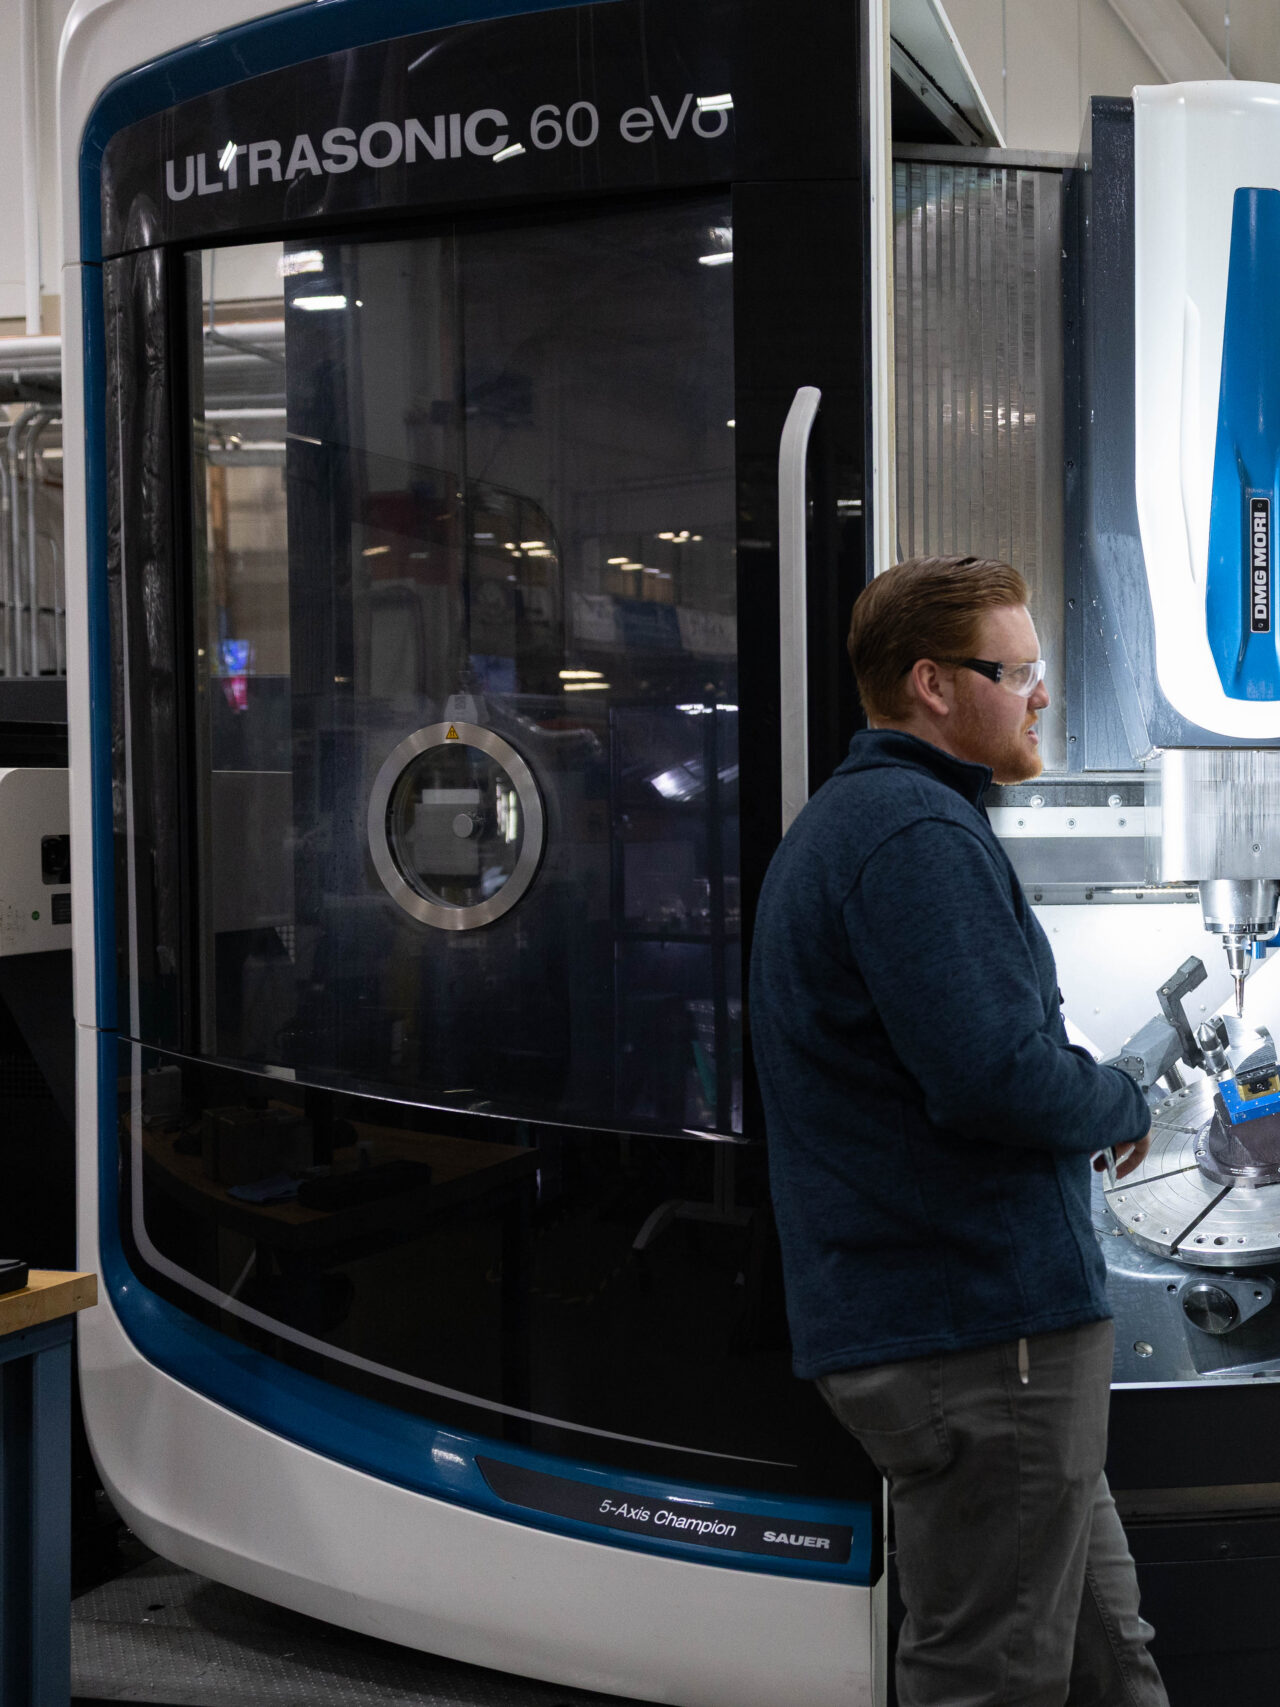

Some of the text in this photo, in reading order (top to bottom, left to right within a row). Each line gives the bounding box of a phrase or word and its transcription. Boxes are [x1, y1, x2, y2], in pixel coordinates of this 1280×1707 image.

[165, 93, 729, 201] ULTRASONIC 60 eVo
[1254, 512, 1267, 619] DMG MORI
[599, 1499, 736, 1537] 5-Axis Champion
[763, 1531, 830, 1549] SAUER
